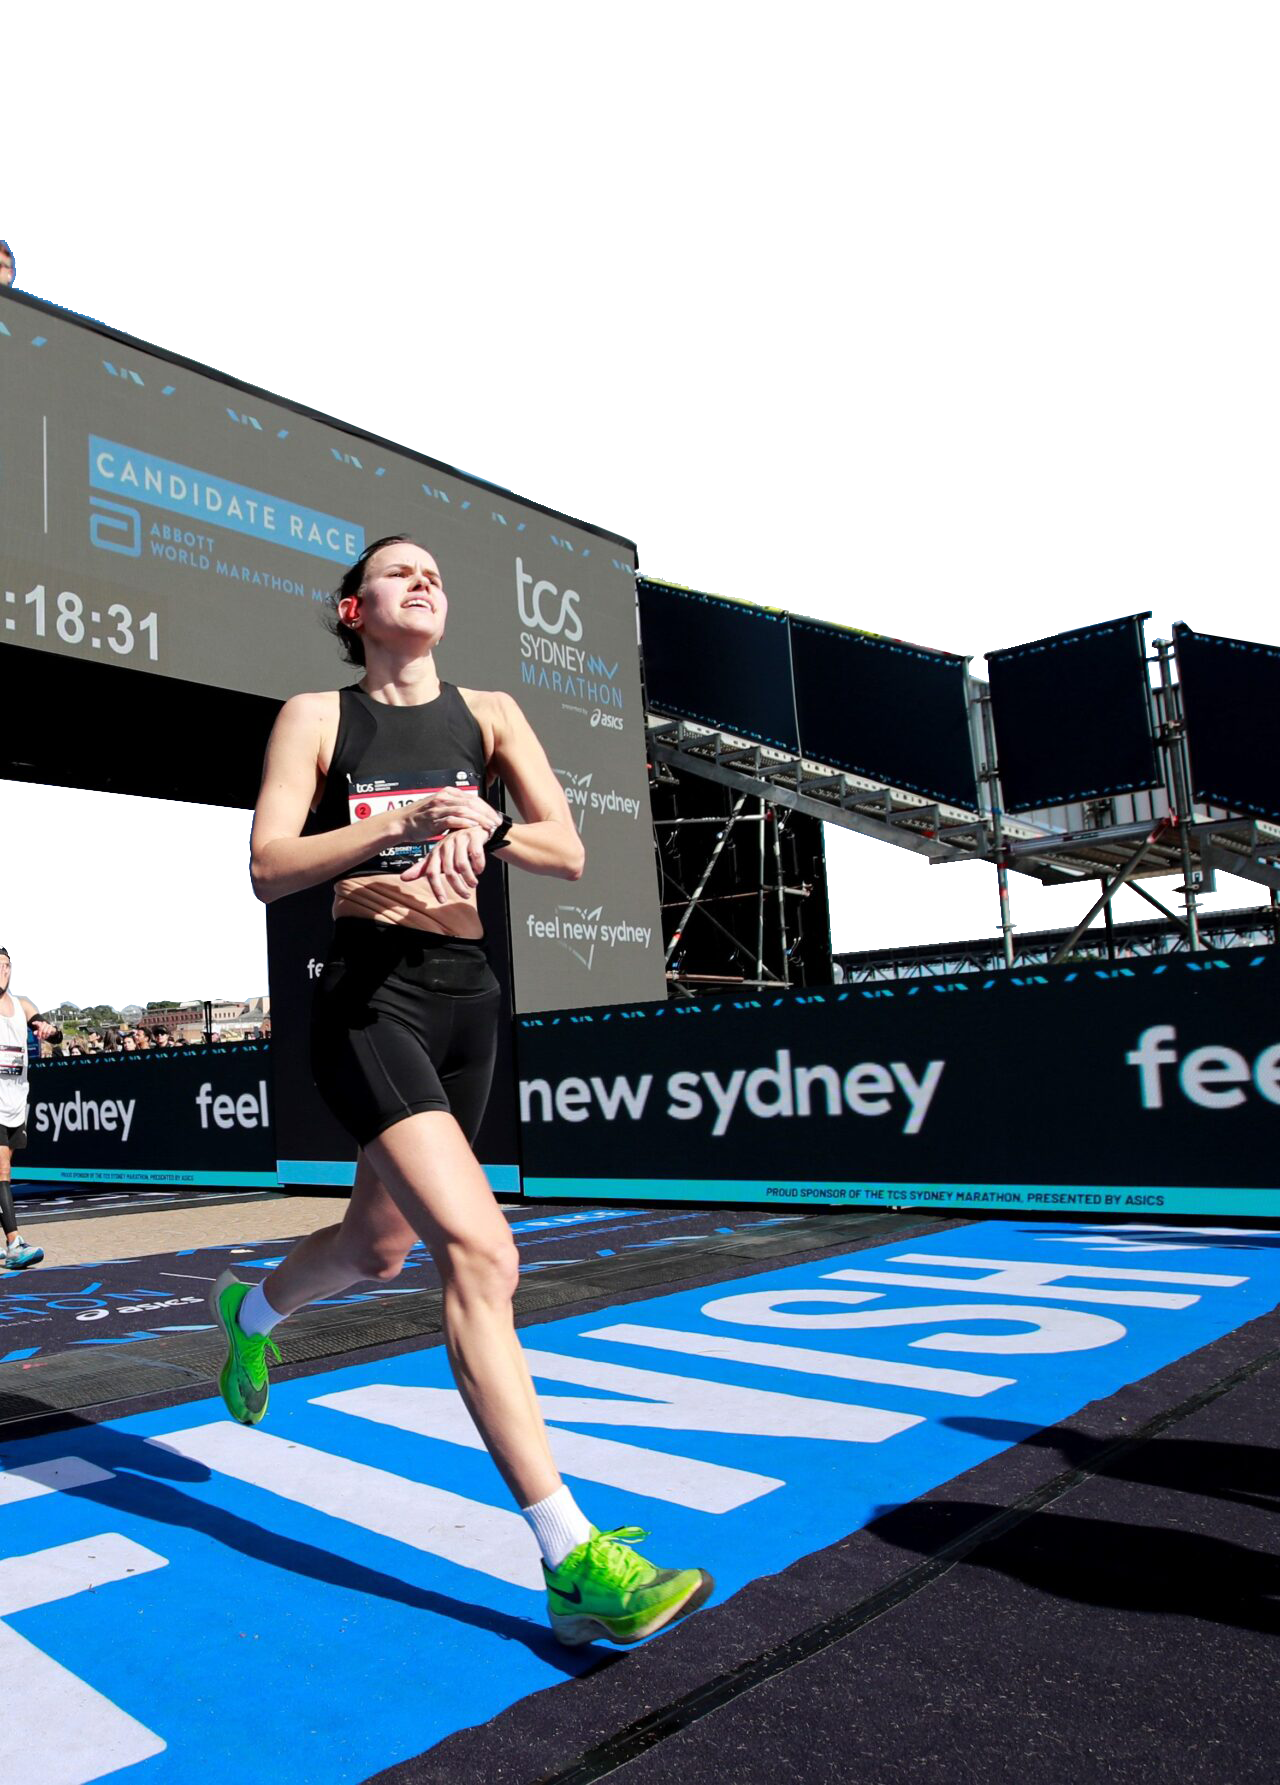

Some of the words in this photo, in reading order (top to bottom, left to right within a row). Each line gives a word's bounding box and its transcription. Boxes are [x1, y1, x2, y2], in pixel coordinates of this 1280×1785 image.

[96, 452, 276, 531] CANDIDATE
[290, 514, 356, 556] RACE
[150, 523, 215, 552] ABBOTT
[150, 540, 210, 570] WORLD
[216, 560, 305, 597] MARATHON
[516, 557, 583, 642] tcs
[520, 632, 586, 674] SYDNEY
[521, 661, 623, 709] MARATHON
[601, 713, 624, 730] asics
[356, 783, 375, 793] tcs
[564, 787, 589, 807] ew
[591, 790, 641, 821] sydney
[527, 914, 560, 939] feel
[563, 921, 599, 940] new
[601, 920, 652, 949] sydney
[307, 958, 324, 979] fe
[196, 1080, 269, 1130] feel
[519, 1073, 654, 1123] new
[666, 1049, 946, 1136] sydney
[35, 1090, 136, 1142] sydney
[766, 1187, 798, 1198] PROUD
[800, 1188, 846, 1199] SPONSOR
[848, 1189, 861, 1199] OF
[864, 1189, 884, 1200] THE
[887, 1189, 907, 1200] TCS
[910, 1190, 953, 1201] SYDNEY
[1027, 1192, 1102, 1205] PRESENTED
[1104, 1194, 1122, 1205] BY
[1125, 1194, 1165, 1207] ASICS
[117, 1294, 205, 1315] asics
